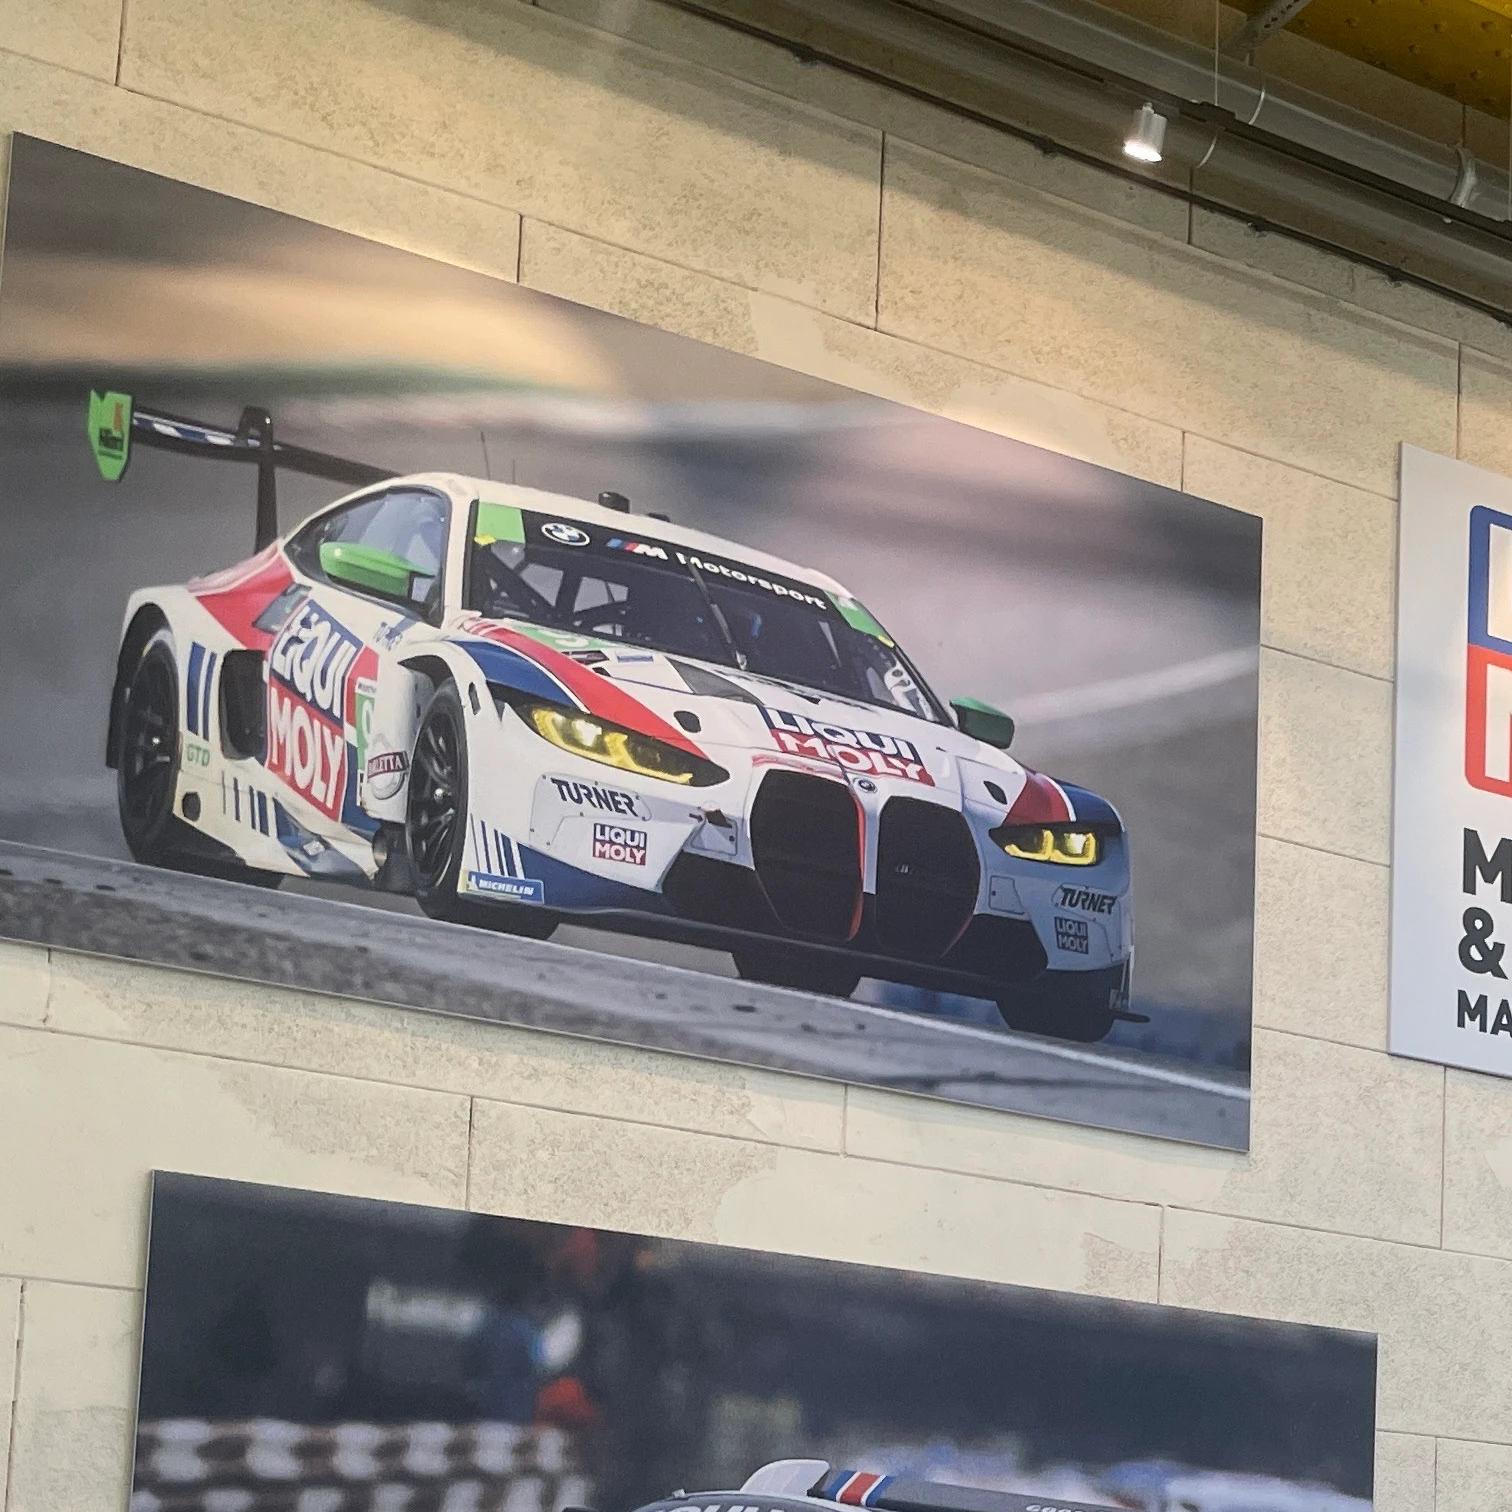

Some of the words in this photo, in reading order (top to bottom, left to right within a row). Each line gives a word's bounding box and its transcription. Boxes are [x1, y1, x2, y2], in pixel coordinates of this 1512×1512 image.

[676, 551, 827, 610] Motorsport
[273, 605, 358, 718] LIQUI
[271, 687, 343, 809] MOLY
[767, 708, 915, 760] LIQUI
[778, 731, 924, 780] MOLY
[550, 778, 638, 817] TURNER
[595, 825, 646, 846] LIQUI
[595, 843, 646, 865] MOLY
[479, 880, 535, 896] MICHELIN
[1060, 887, 1117, 914] TURNER
[1458, 907, 1508, 978] &
